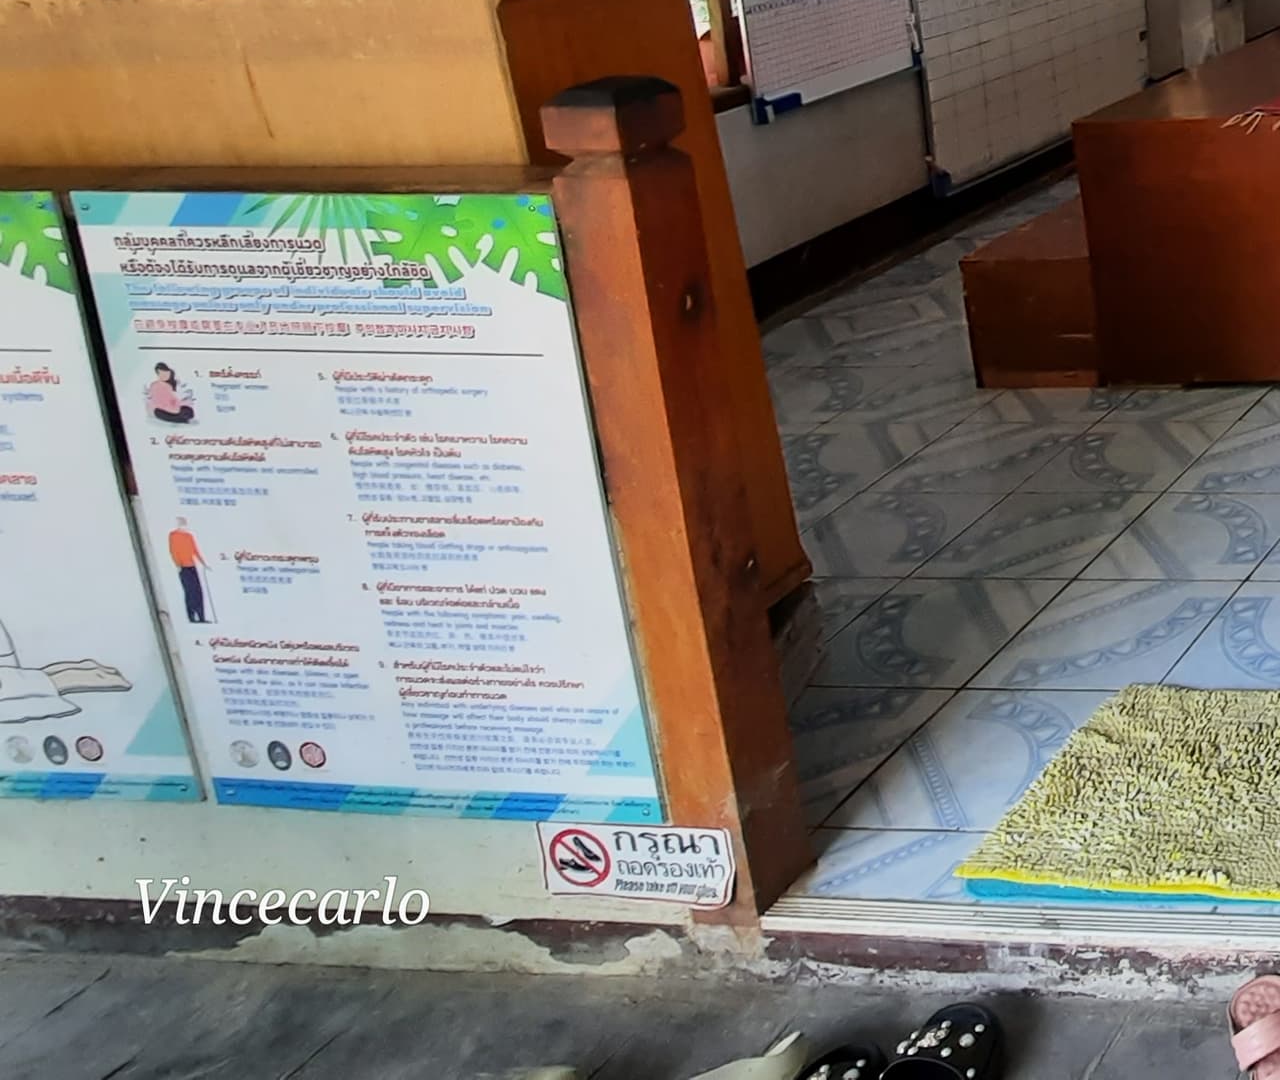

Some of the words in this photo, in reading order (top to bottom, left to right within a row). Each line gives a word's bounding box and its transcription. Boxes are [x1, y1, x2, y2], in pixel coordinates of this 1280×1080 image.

[612, 830, 721, 860] กรุณา
[616, 857, 726, 879] ถอดรองเท้า
[614, 879, 645, 892] Please
